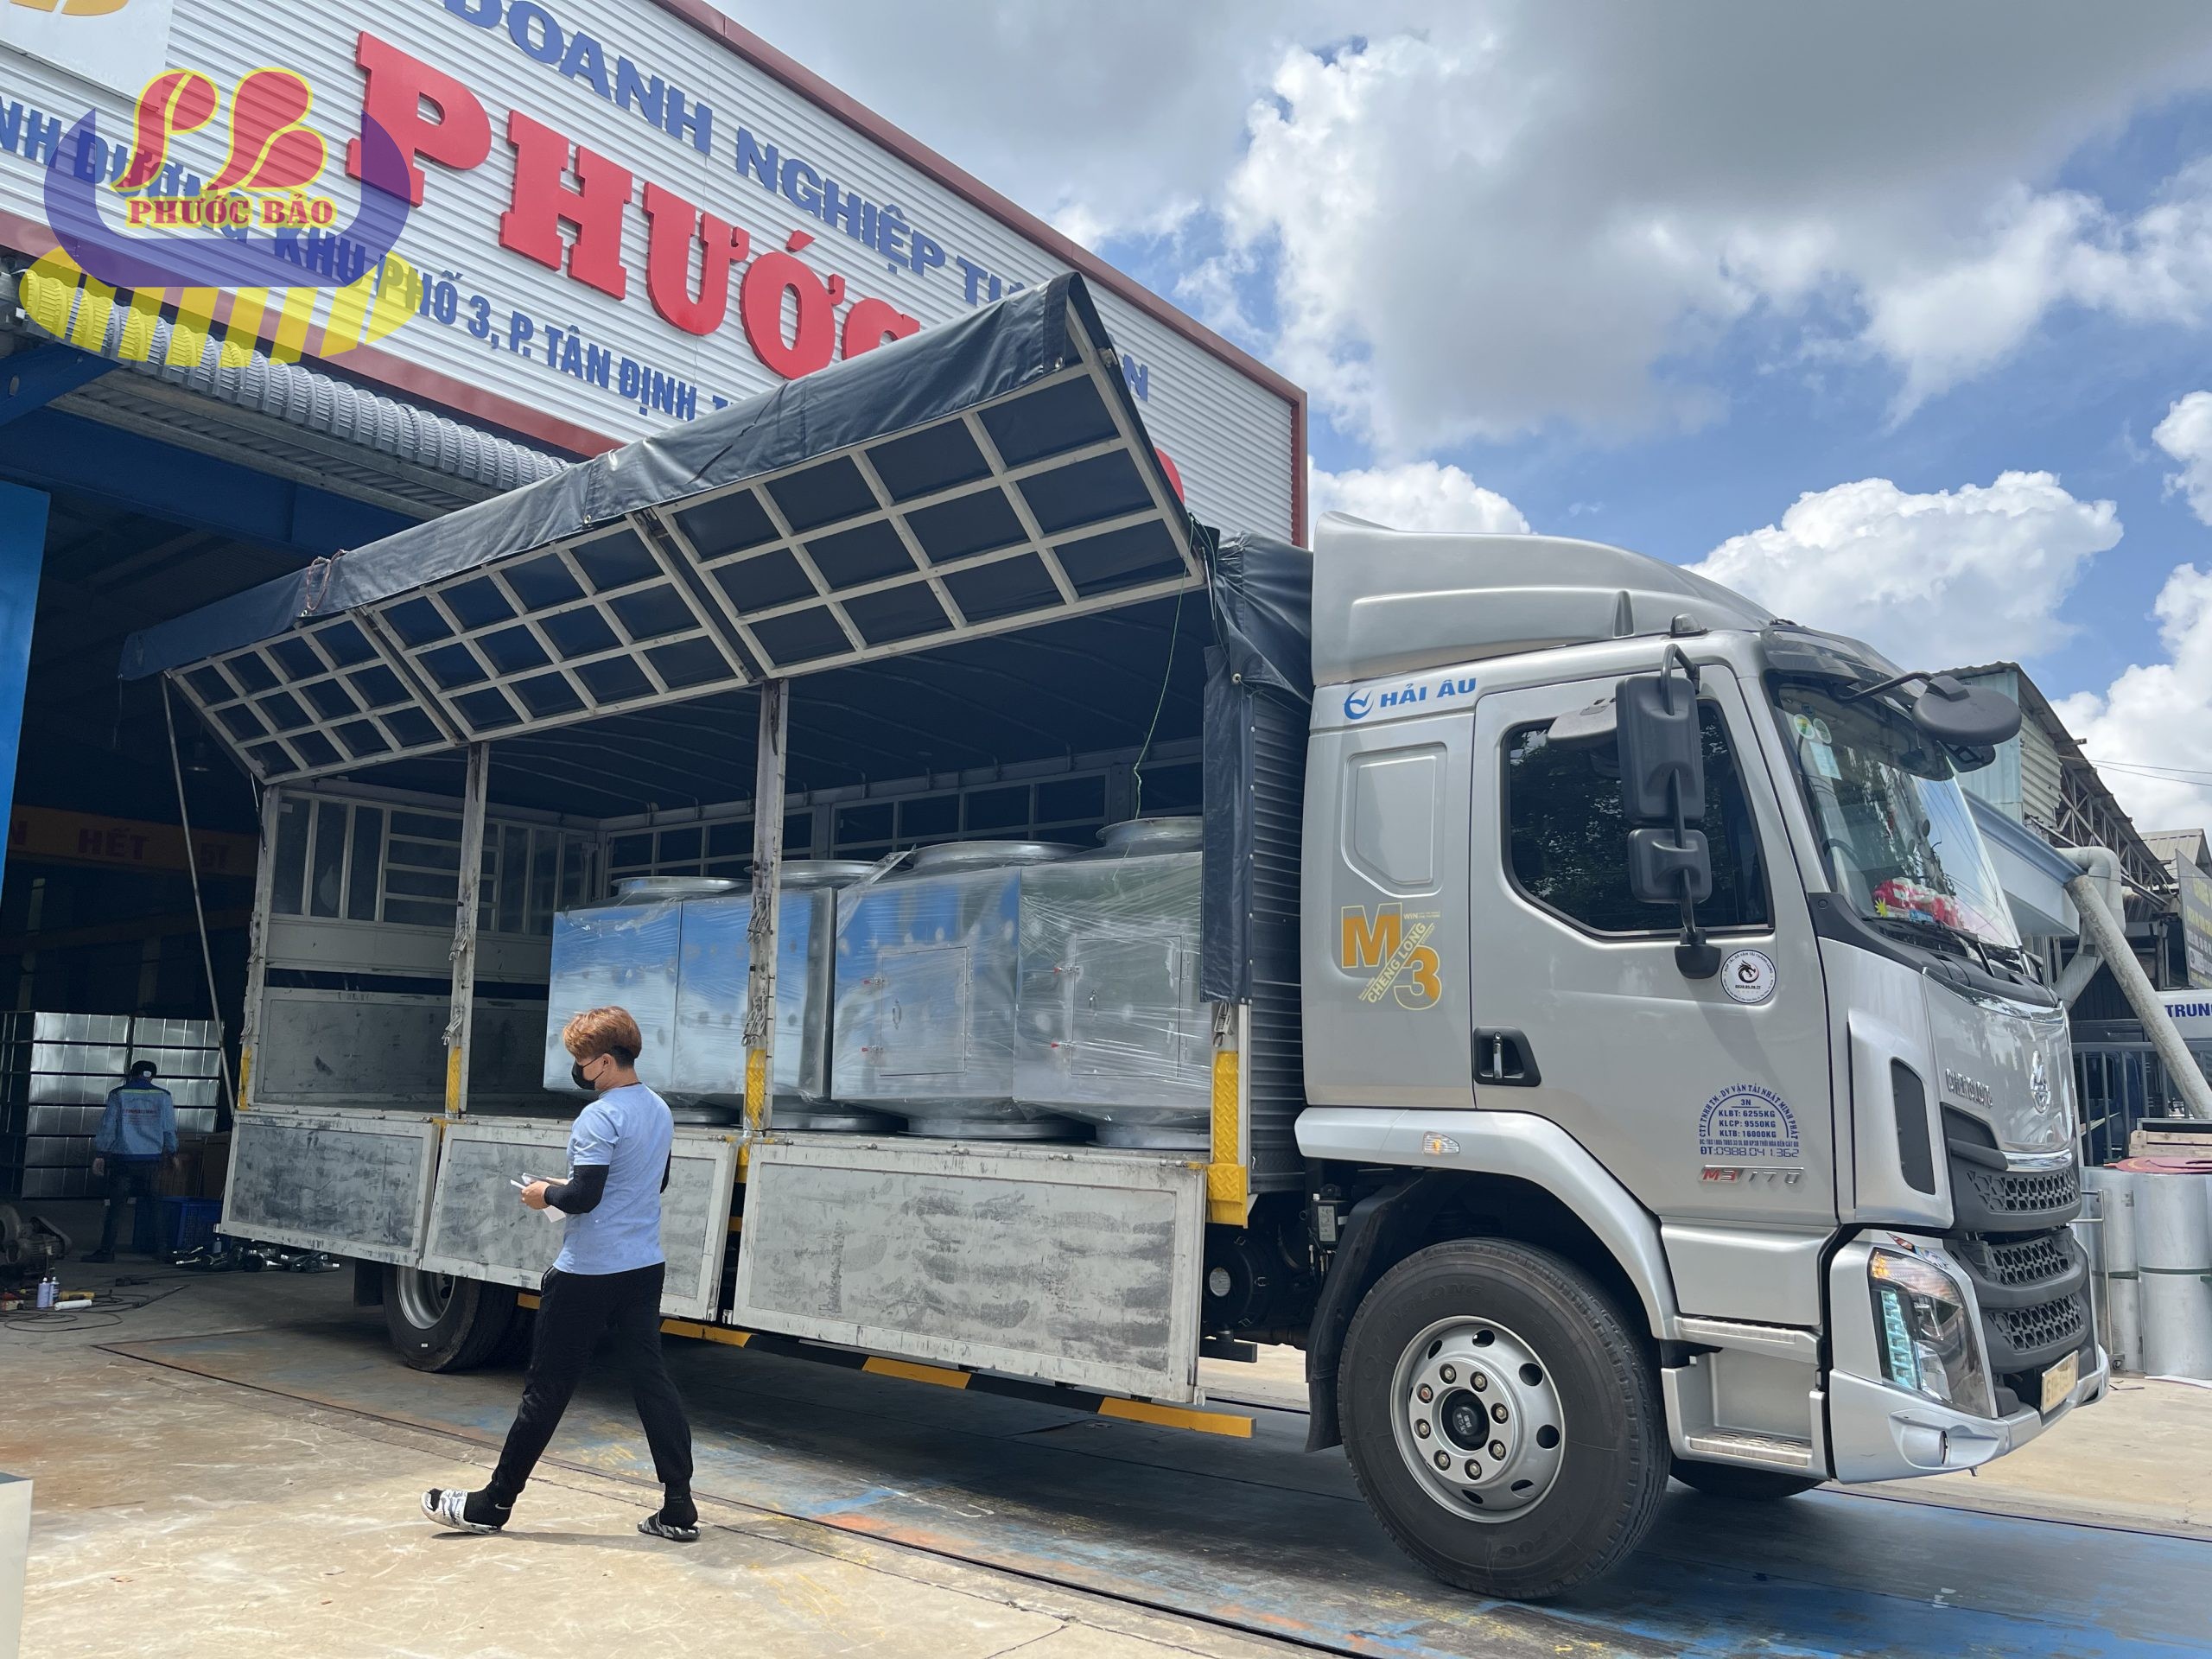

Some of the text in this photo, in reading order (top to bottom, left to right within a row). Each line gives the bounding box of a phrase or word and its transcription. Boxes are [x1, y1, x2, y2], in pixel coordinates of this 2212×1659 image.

[737, 126, 946, 276] NGHIỆP
[375, 254, 463, 325] PHỐ
[619, 356, 697, 421] ĐỊNH
[1380, 677, 1477, 708] HẢI ÂU
[1368, 922, 1427, 1003] CHENG LONG
[2164, 1004, 2212, 1018] TRUN
[1700, 1103, 1713, 1122] TNHH
[1732, 1083, 1746, 1093] VẬN
[1748, 1083, 1761, 1093] TẢI
[1778, 1102, 1794, 1120] MINH
[1789, 1120, 1799, 1140] PHÁT
